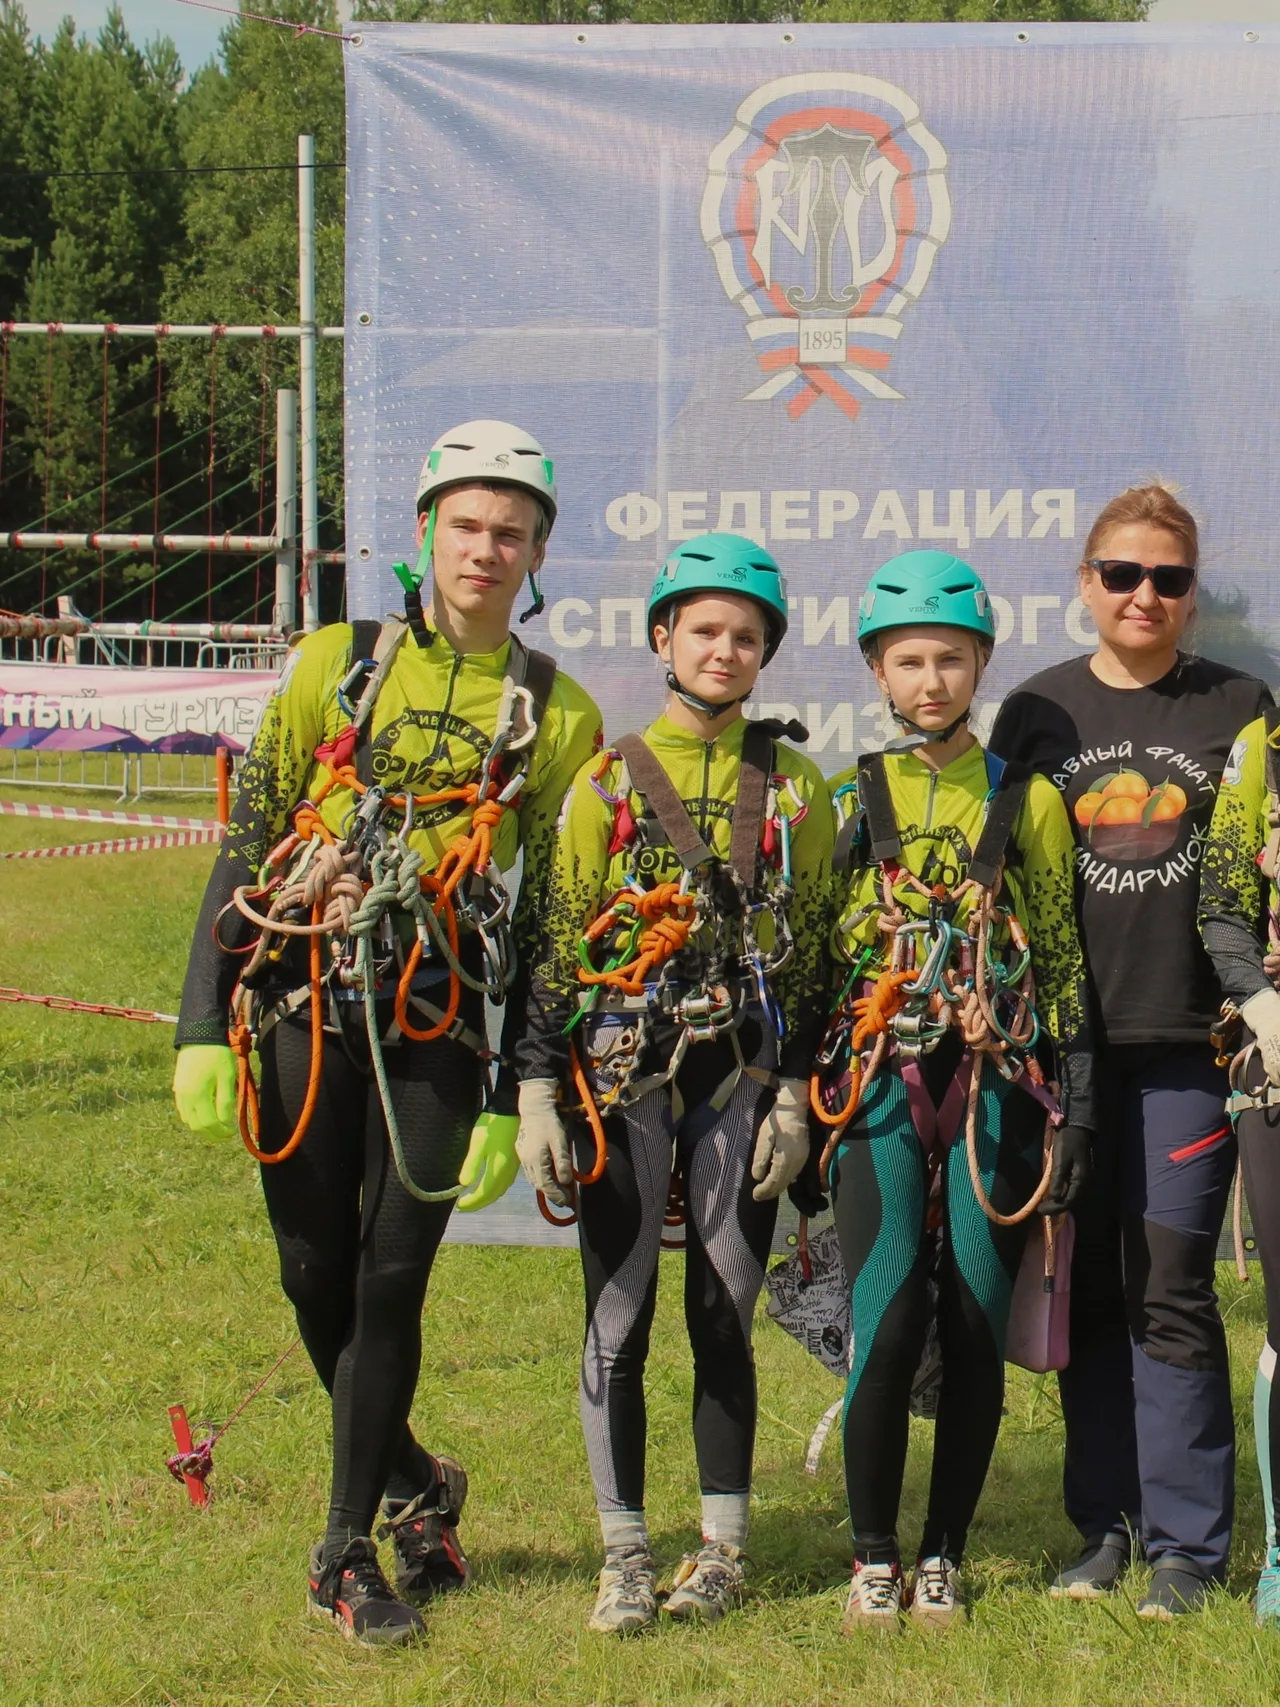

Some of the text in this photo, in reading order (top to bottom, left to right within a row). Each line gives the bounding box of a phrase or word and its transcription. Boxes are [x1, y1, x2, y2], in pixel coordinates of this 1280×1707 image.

[802, 331, 844, 351] 1895
[605, 488, 1076, 548] ФЕДЕРАЦИЯ
[716, 572, 744, 582] VENTO
[2, 688, 263, 736] НЫЙ ТУРИЗ
[1052, 740, 1216, 795] АВНЫЙ ФАНАТ
